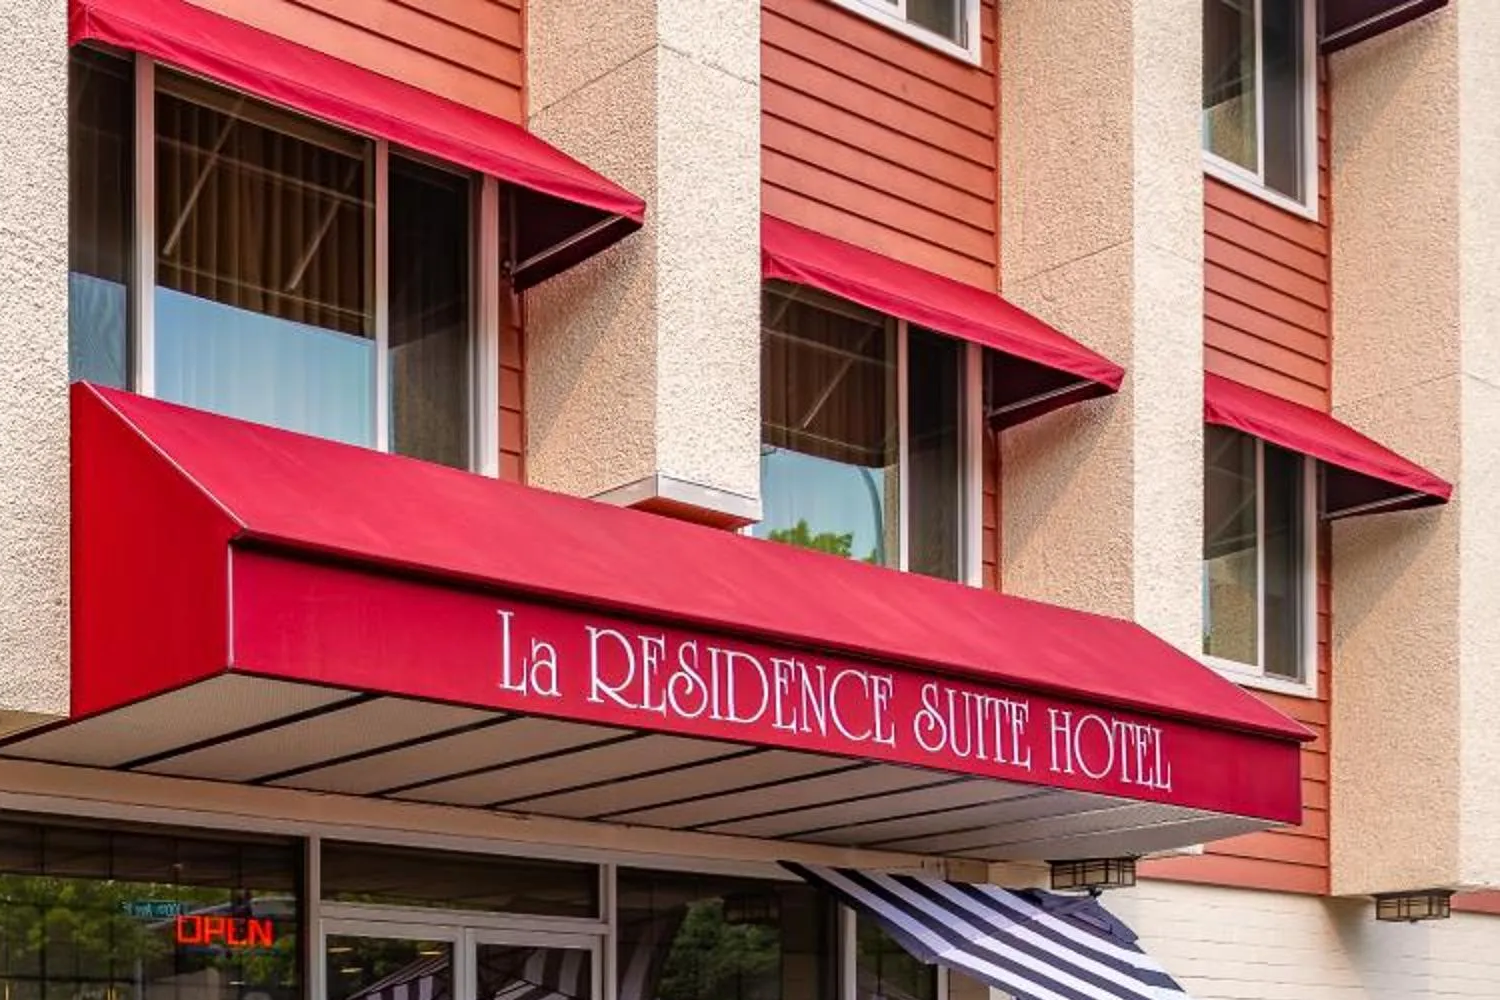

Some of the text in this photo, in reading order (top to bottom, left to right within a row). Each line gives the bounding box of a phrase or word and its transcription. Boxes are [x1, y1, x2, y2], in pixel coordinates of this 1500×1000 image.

[497, 610, 1173, 793] La RESIDENCE SUITE HOTEL
[176, 914, 274, 947] OPEN
